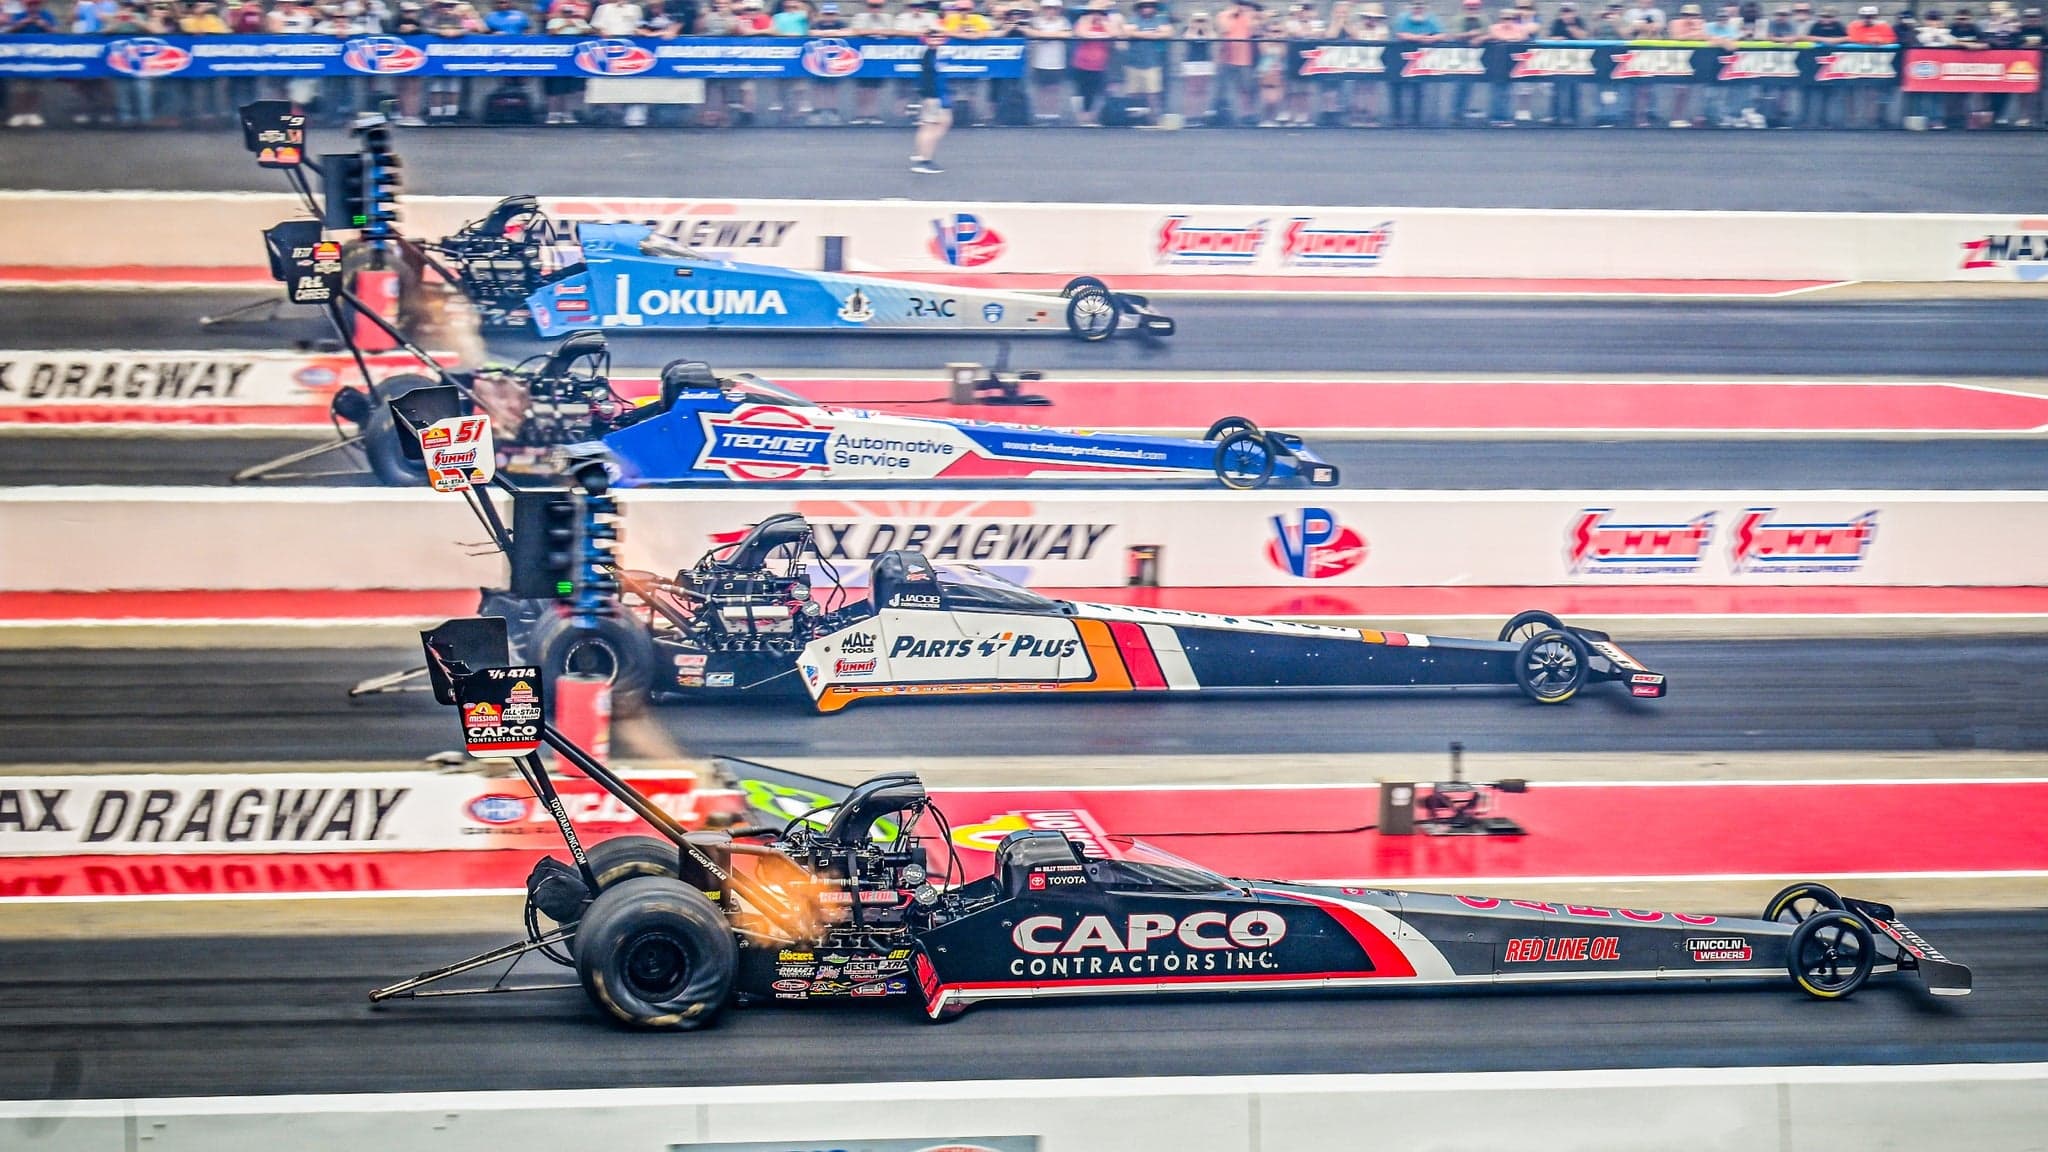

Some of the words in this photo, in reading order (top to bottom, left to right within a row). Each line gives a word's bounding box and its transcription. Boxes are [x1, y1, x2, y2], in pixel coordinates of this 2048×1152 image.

[639, 290, 788, 315] OKUMA
[907, 298, 956, 317] RAC
[25, 363, 251, 398] DRAGWAY
[455, 420, 486, 443] 51
[834, 434, 953, 455] Automotive
[833, 450, 910, 468] Service
[866, 523, 1118, 560] DRAGWAY
[901, 595, 940, 604] JACOB
[842, 632, 874, 648] MAC
[888, 635, 973, 658] PARTS
[1008, 634, 1080, 657] PLUS
[507, 668, 536, 678] 474
[468, 726, 538, 738] CAPCO
[468, 736, 521, 744] CONTRACTORS
[80, 787, 412, 842] DRAGWAY
[550, 797, 587, 865] TOYOTARACING.COM
[688, 849, 728, 881] GOODYEAR
[1048, 876, 1087, 885] TOYOTA
[1013, 911, 1286, 954] CAPCO
[1505, 938, 1544, 962] RED
[1544, 938, 1590, 961] LINE
[1590, 937, 1620, 960] OIL
[1689, 940, 1732, 951] LINCOLN
[1699, 950, 1746, 960] WELDERS
[1011, 954, 1216, 976] CONTRACTORS
[1226, 952, 1279, 970] INC.
